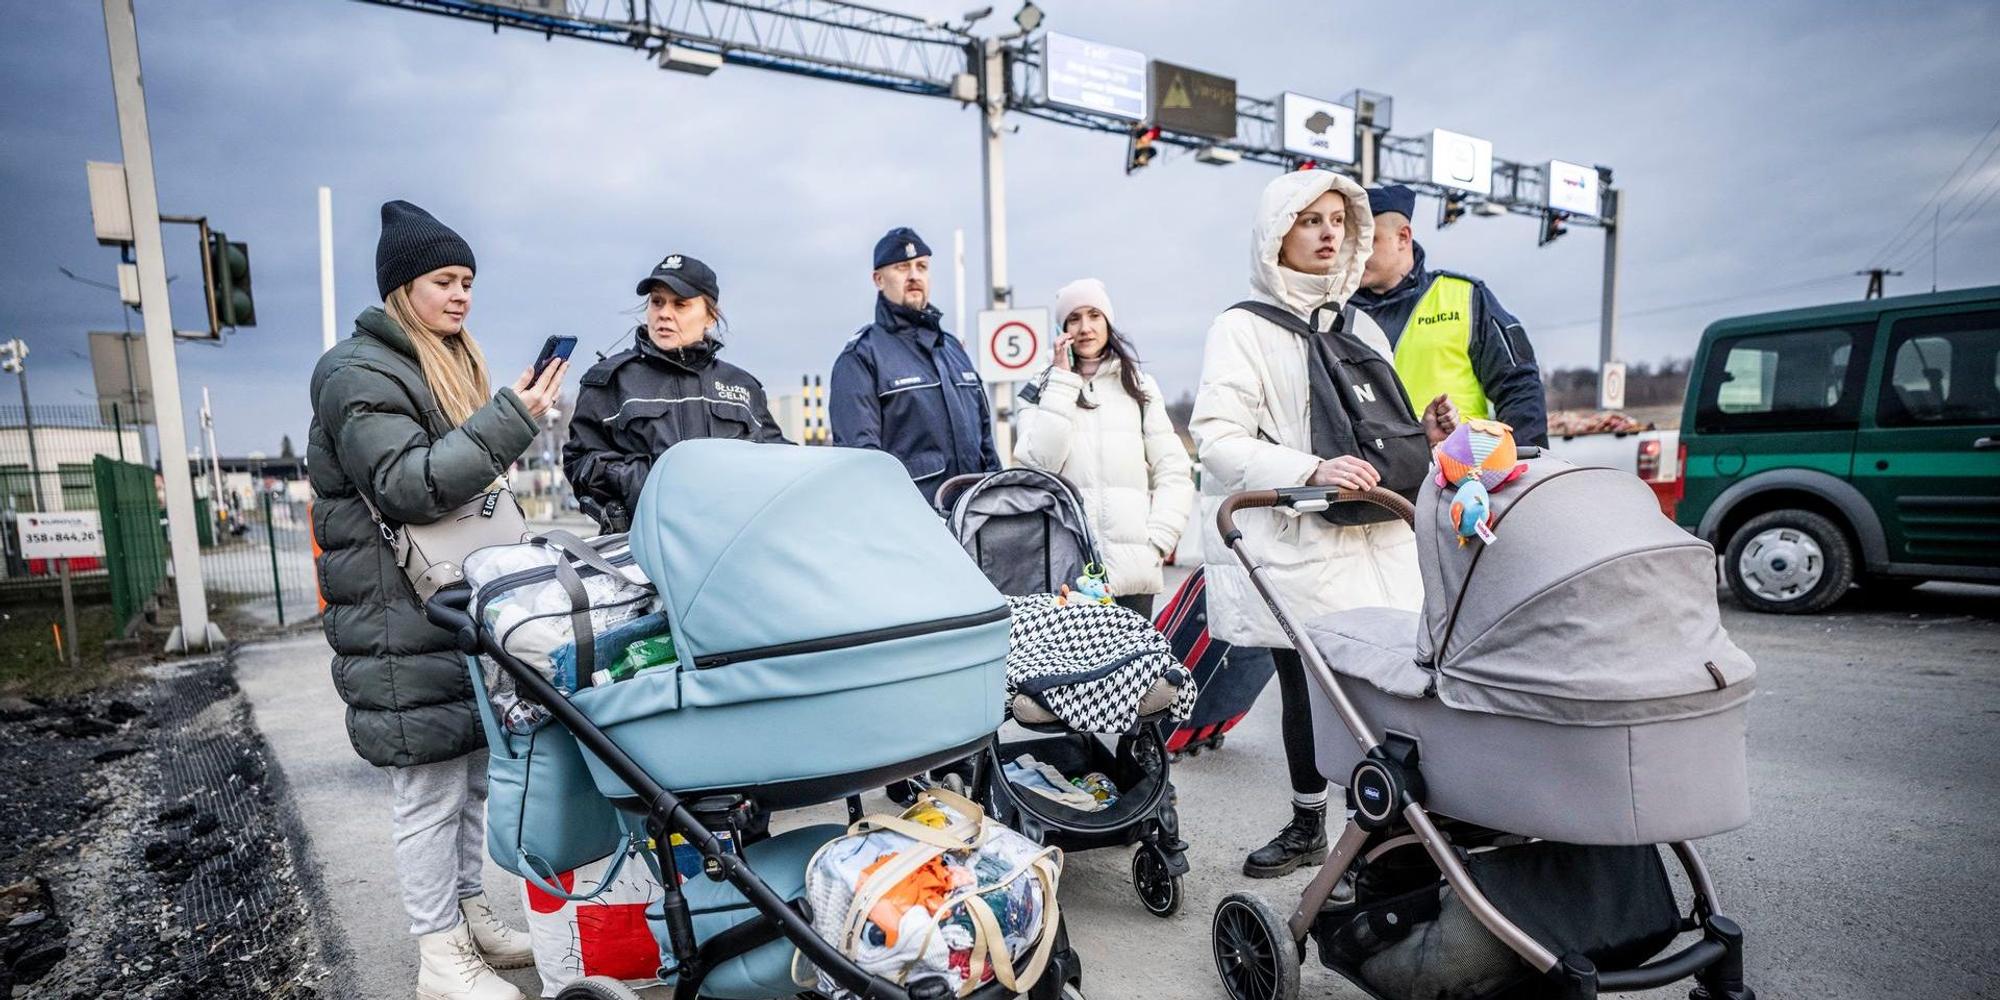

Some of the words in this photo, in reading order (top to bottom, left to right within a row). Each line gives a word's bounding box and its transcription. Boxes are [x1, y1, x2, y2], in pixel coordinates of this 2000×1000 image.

[1417, 311, 1460, 325] POLICJA
[1007, 335, 1020, 358] 5
[1353, 383, 1376, 403] N
